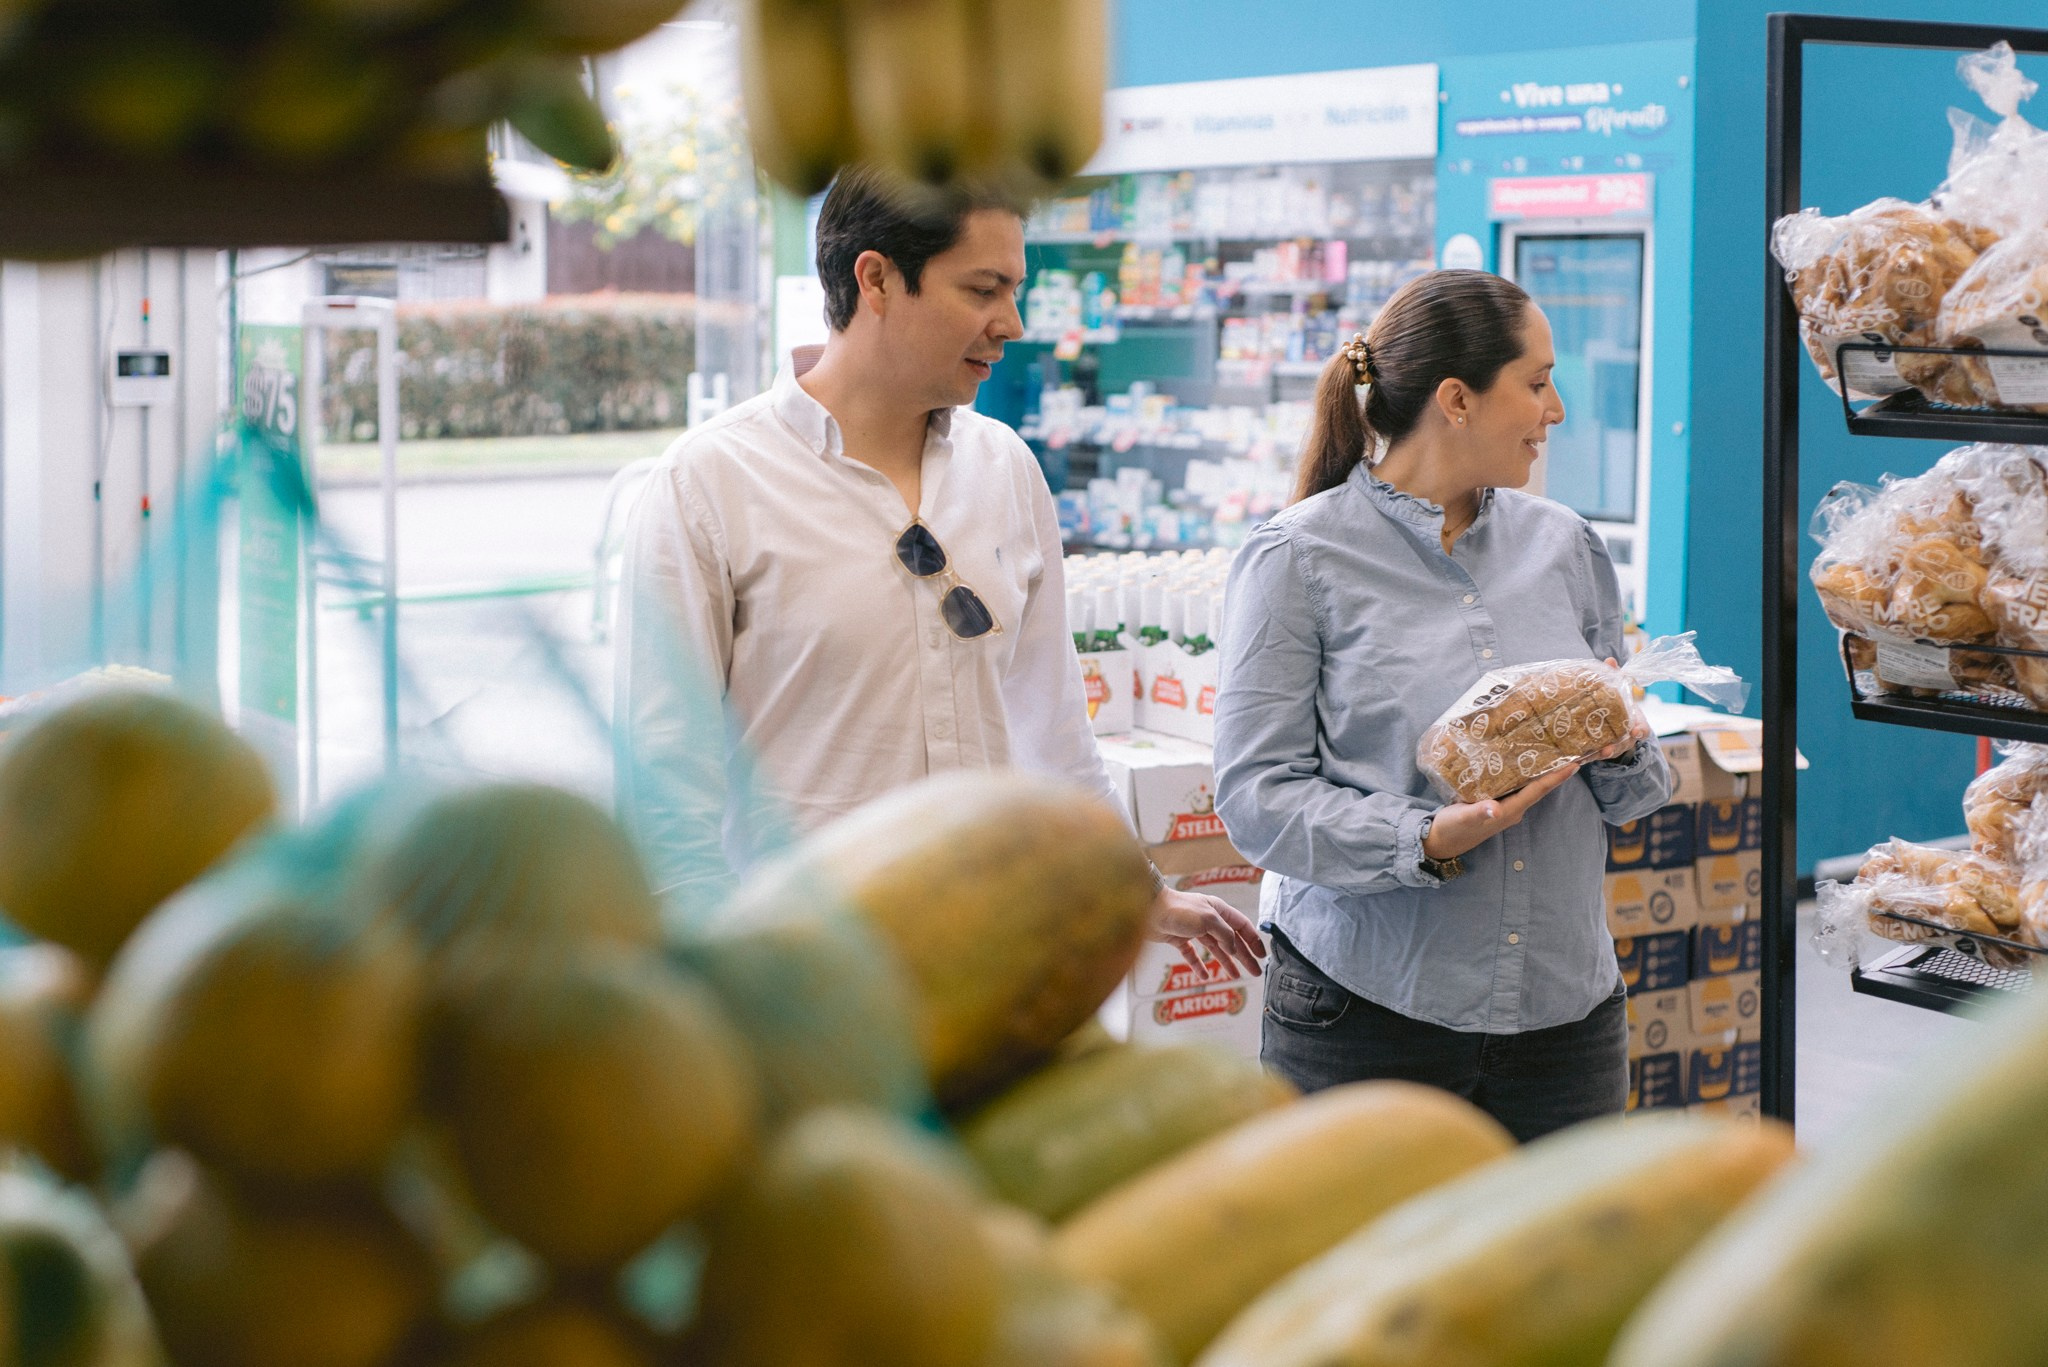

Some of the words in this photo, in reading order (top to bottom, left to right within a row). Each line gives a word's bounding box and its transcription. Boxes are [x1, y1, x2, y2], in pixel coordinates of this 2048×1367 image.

[1512, 83, 1563, 107] Vive
[1177, 818, 1227, 840] STELL
[1171, 965, 1231, 989] STELA
[1173, 992, 1230, 1015] ARTOIS
